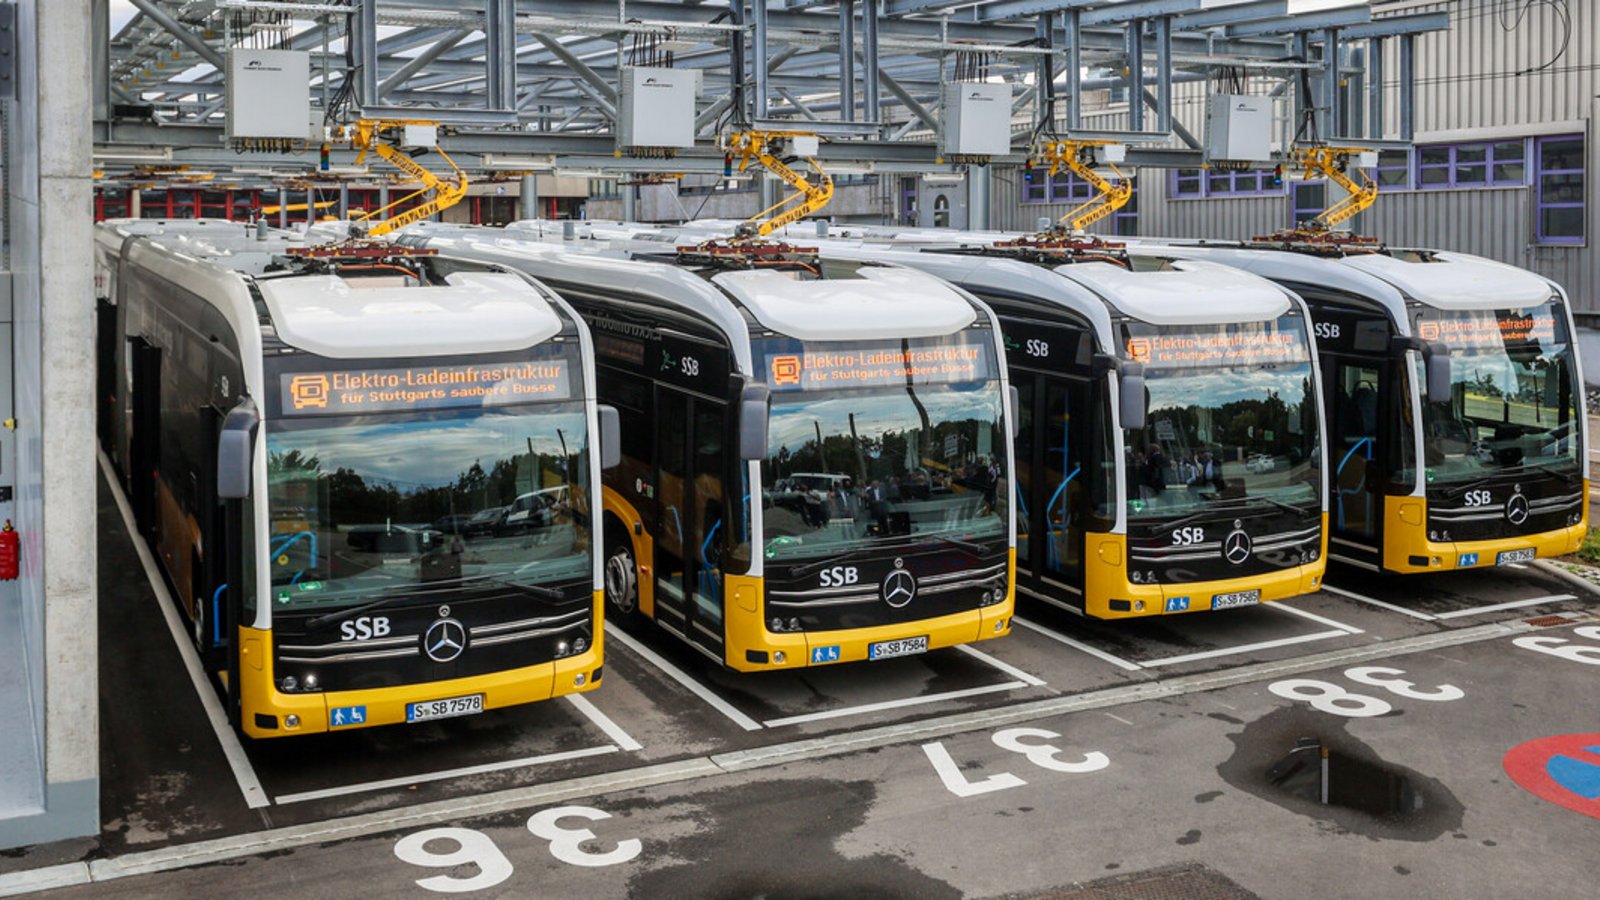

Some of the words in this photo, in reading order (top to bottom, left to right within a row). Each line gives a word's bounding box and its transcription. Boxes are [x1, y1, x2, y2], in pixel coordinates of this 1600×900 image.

[1315, 321, 1341, 338] SSB
[1026, 338, 1049, 357] SSB
[681, 356, 699, 376] SSB
[804, 348, 978, 370] Elektro-Ladeinfrastruktur
[332, 363, 561, 391] Elektro-Ladeinfrastruktur
[810, 370, 828, 381] für
[340, 391, 364, 404] für
[369, 387, 446, 403] Stuttgarts
[450, 386, 509, 398] saubere
[512, 383, 556, 394] Busse
[1464, 489, 1491, 507] SSB
[1172, 527, 1204, 546] SSB
[819, 566, 858, 587] SSB
[340, 616, 391, 641] SSB
[1267, 665, 1465, 717] 38
[450, 696, 480, 712] 7578
[922, 726, 1110, 797] 37
[394, 805, 642, 893] 36
